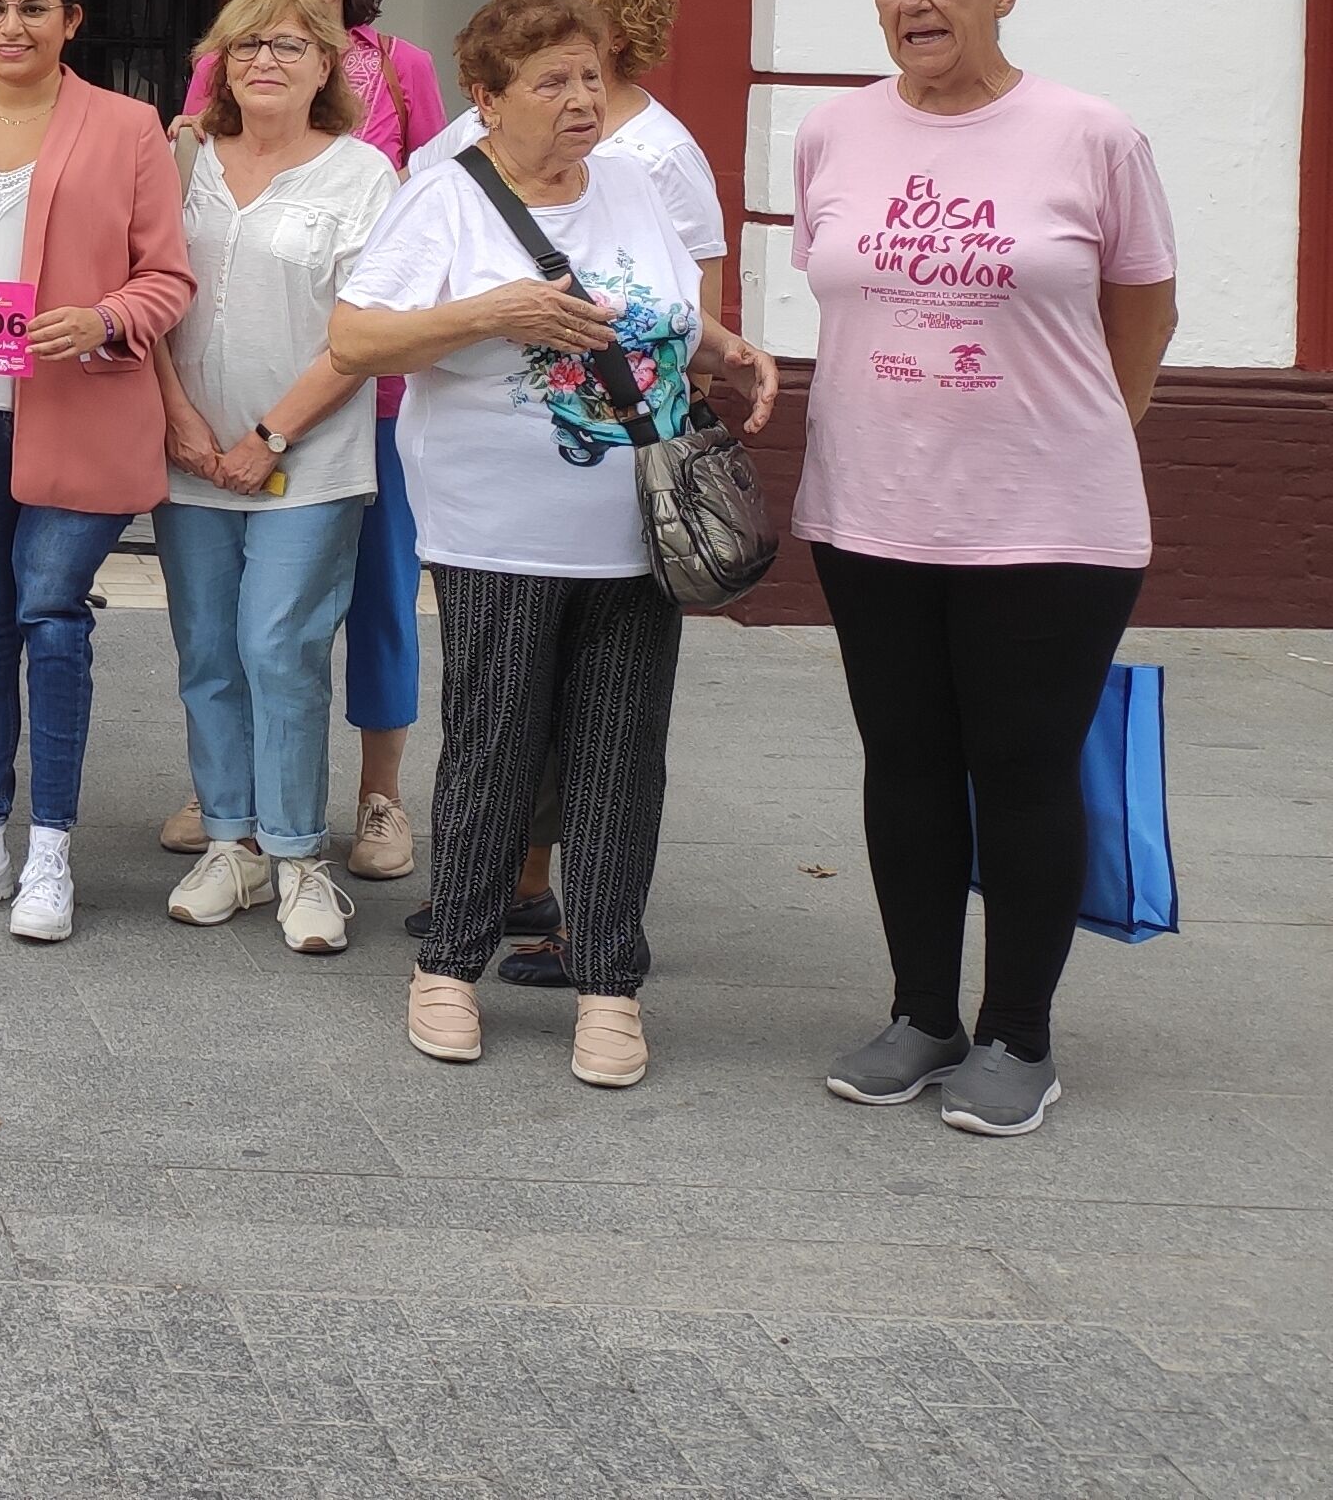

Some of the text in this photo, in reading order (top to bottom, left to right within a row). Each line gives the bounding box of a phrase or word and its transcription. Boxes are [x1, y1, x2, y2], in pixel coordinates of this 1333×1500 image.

[885, 197, 996, 230] ROSA
[857, 227, 1016, 255] es más que
[875, 251, 904, 273] un
[861, 285, 870, 300] 7
[869, 350, 918, 366] Gracias
[875, 364, 926, 378] COTREL
[940, 380, 997, 389] EL CUERVO
